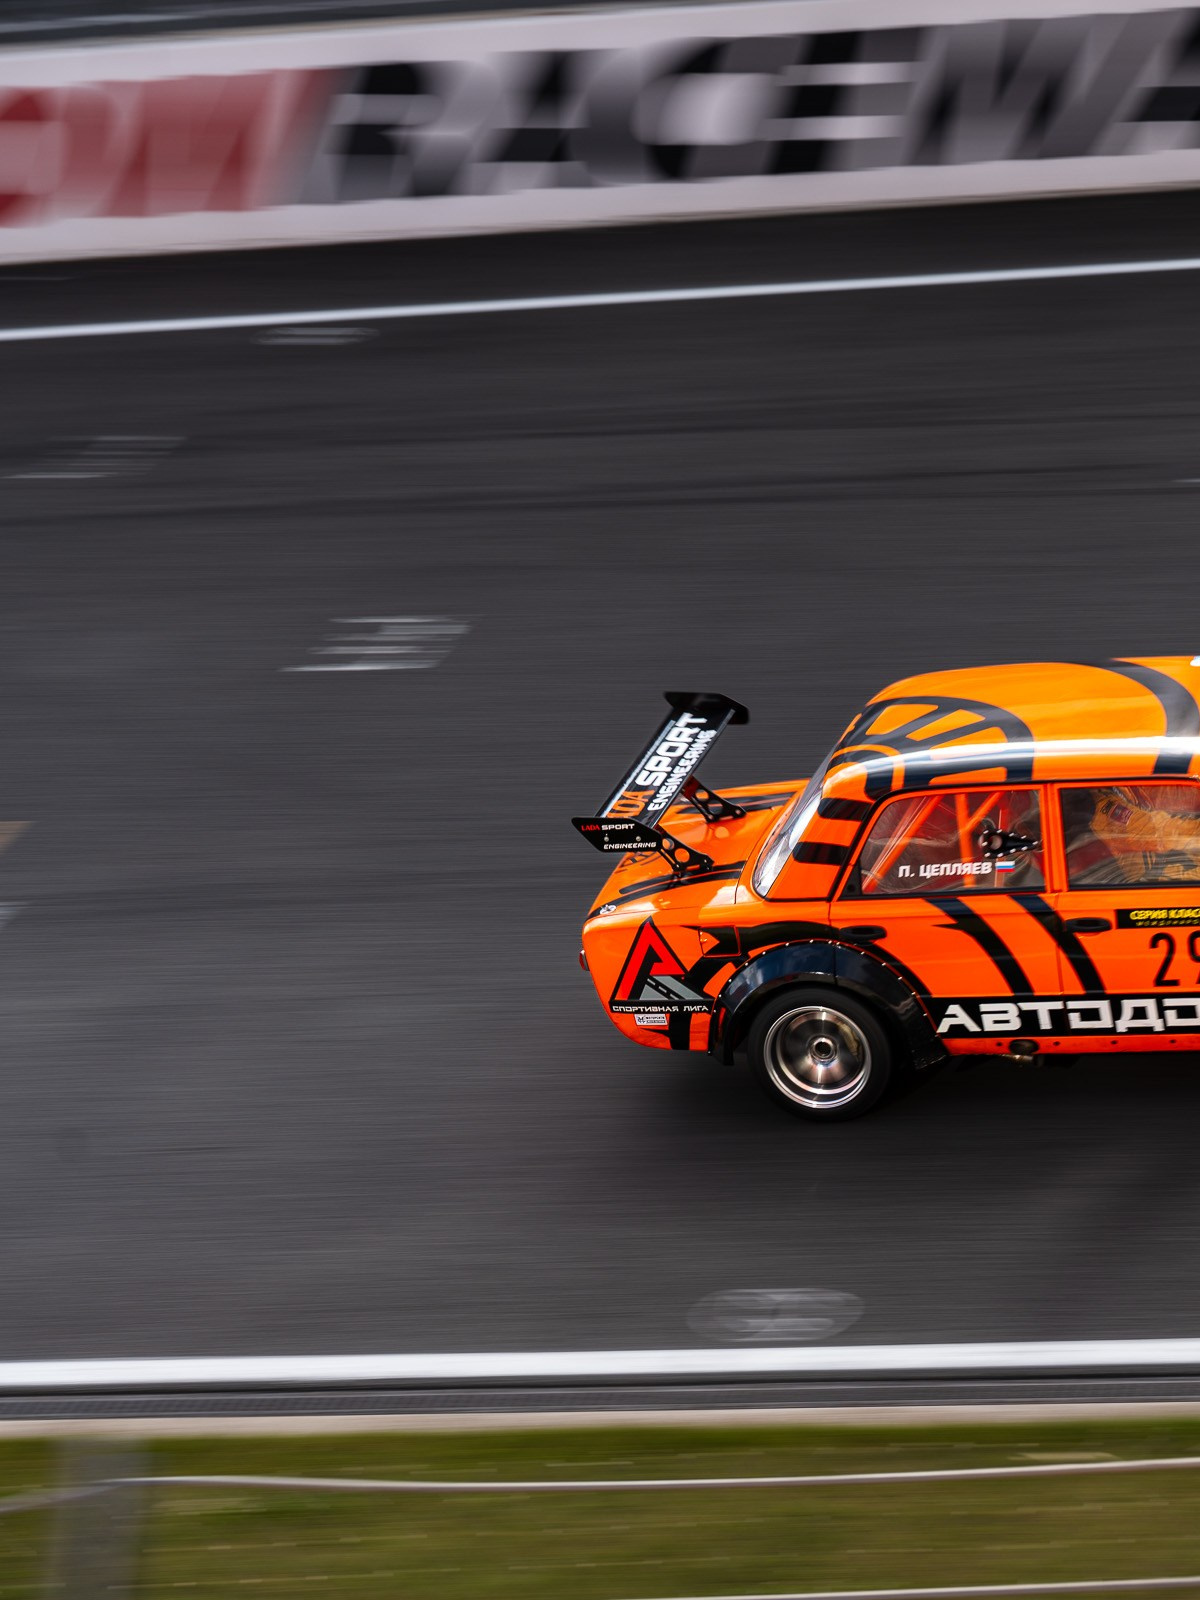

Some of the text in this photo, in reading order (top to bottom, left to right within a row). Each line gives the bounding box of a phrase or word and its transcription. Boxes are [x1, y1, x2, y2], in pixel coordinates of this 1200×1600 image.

[635, 712, 707, 786] SPORT
[647, 729, 717, 811] ENGINEERING
[581, 823, 635, 832] LADA SPORT
[603, 842, 657, 850] ENGINEERING
[919, 861, 993, 879] ЦЕПЛЯЕВ
[612, 1005, 679, 1013] СПОРТИВНАЯ
